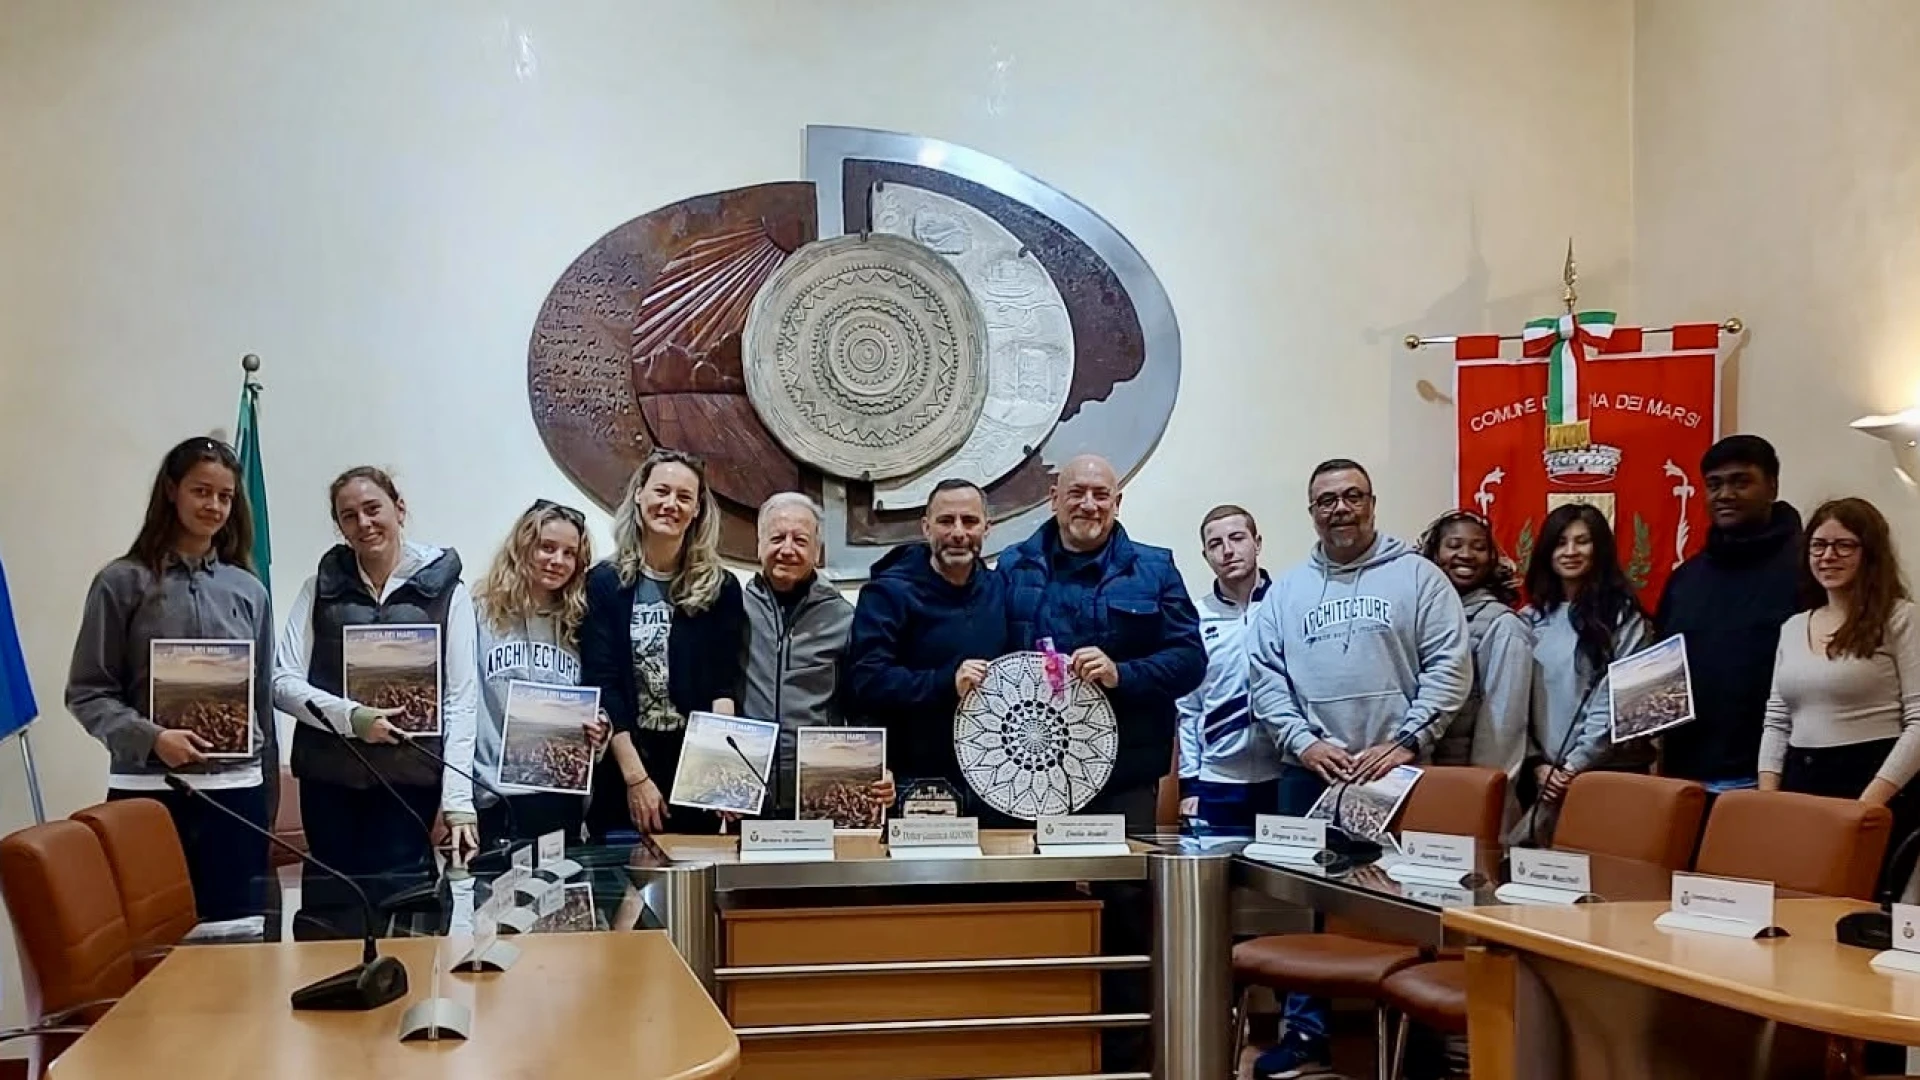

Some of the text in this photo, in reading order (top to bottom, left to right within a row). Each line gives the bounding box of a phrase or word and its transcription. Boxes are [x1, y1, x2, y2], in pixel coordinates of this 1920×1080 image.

[1470, 397, 1538, 432] COMUNE
[1615, 394, 1644, 411] DEI
[1646, 397, 1702, 429] MARSI
[1302, 597, 1391, 639] ARCHITECTURE
[486, 641, 581, 687] ARCHIECTURE
